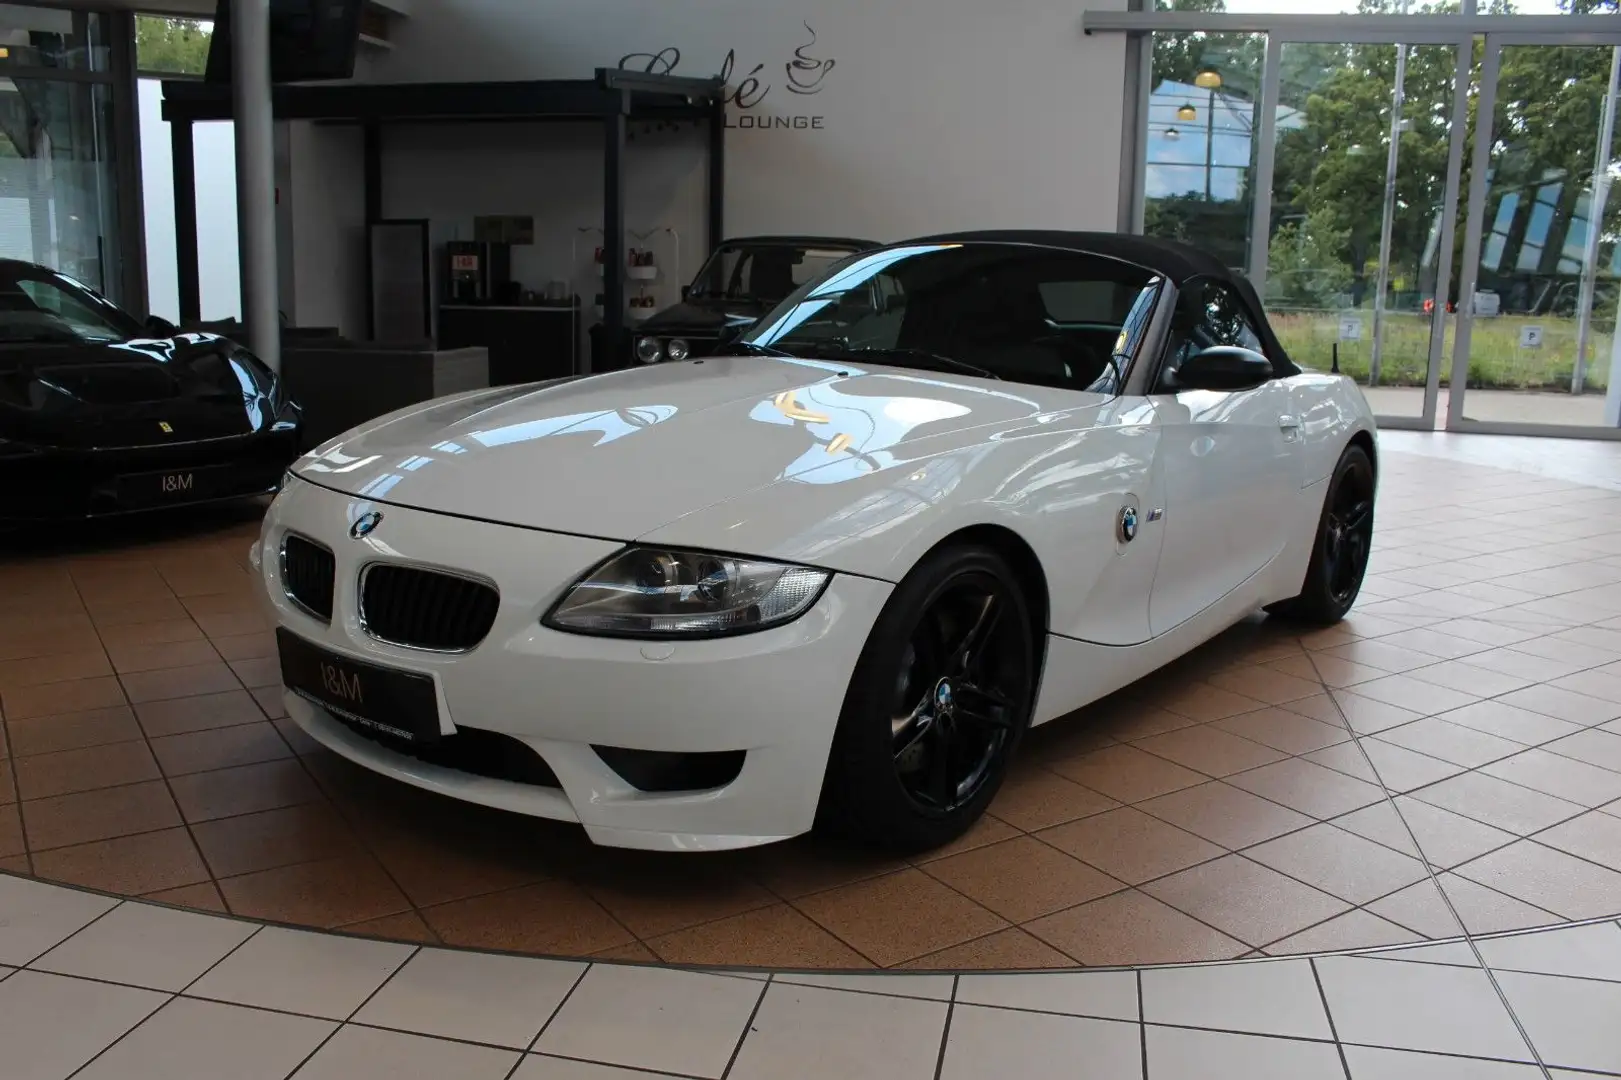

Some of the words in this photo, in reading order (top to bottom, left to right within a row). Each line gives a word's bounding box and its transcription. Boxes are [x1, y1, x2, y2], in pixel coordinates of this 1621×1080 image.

[723, 114, 825, 130] LOUNGE
[162, 473, 194, 492] I&M
[320, 661, 364, 704] I&M
